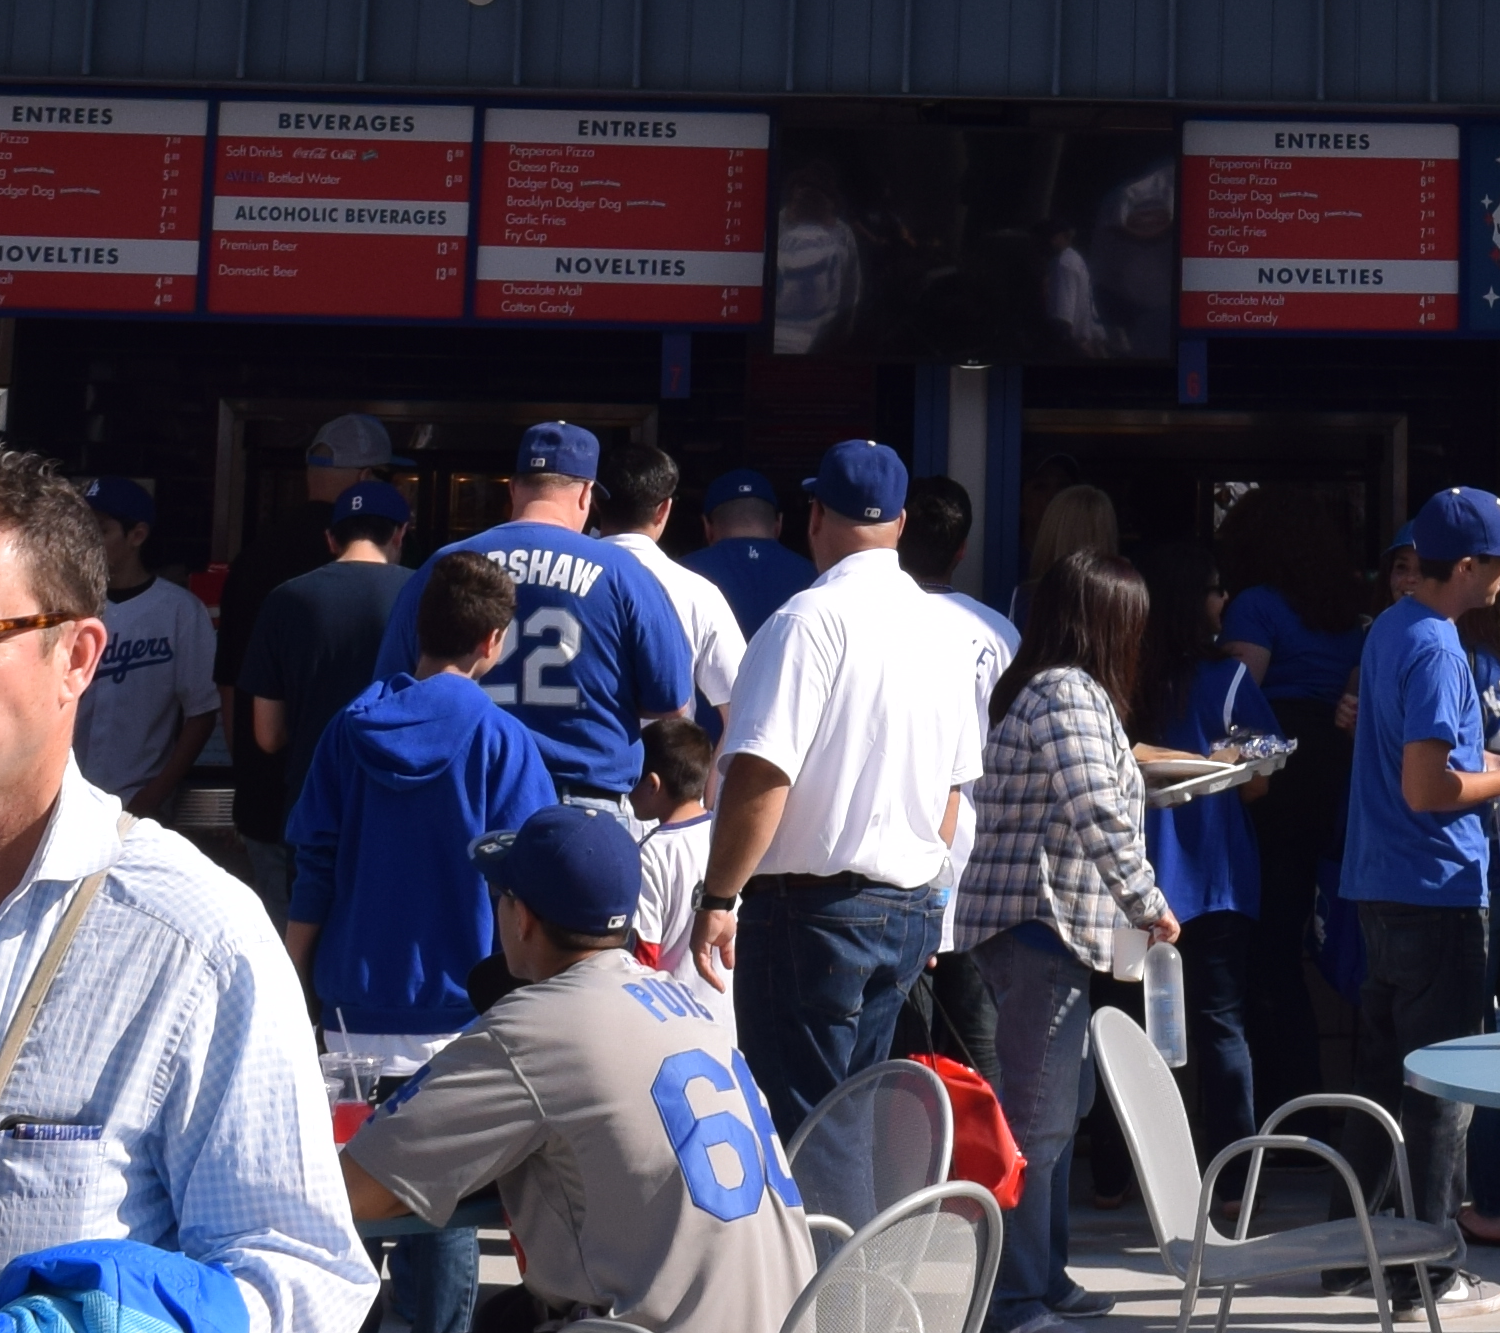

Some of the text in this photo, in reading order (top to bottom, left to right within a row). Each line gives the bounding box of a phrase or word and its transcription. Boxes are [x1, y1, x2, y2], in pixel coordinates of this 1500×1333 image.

[11, 105, 112, 125] ENTREES
[277, 112, 414, 133] BEVERAGES
[577, 118, 676, 138] ENTREES
[1274, 132, 1370, 150] ENTREES
[1208, 156, 1292, 171] Pepperoni Pizza
[1208, 173, 1277, 185] Cheese Pizza
[1208, 189, 1247, 204] Dodger
[1249, 189, 1272, 204] Dog
[234, 204, 446, 225] ALCOHOLIC BEVERAGES
[1208, 207, 1253, 221] Brooklyn
[1255, 207, 1295, 223] Dodger
[1296, 207, 1320, 223] Dog
[1207, 224, 1267, 237] Garlic Fries
[1207, 239, 1249, 255] Fry Cup
[555, 256, 685, 276] NOVELTIES
[1257, 267, 1383, 285] NOVELTIES
[1207, 293, 1285, 306] Chocolate Malt
[1206, 310, 1278, 326] Cotton Candy
[1186, 371, 1201, 399] 6
[351, 495, 363, 510] B
[101, 632, 173, 684] dgers
